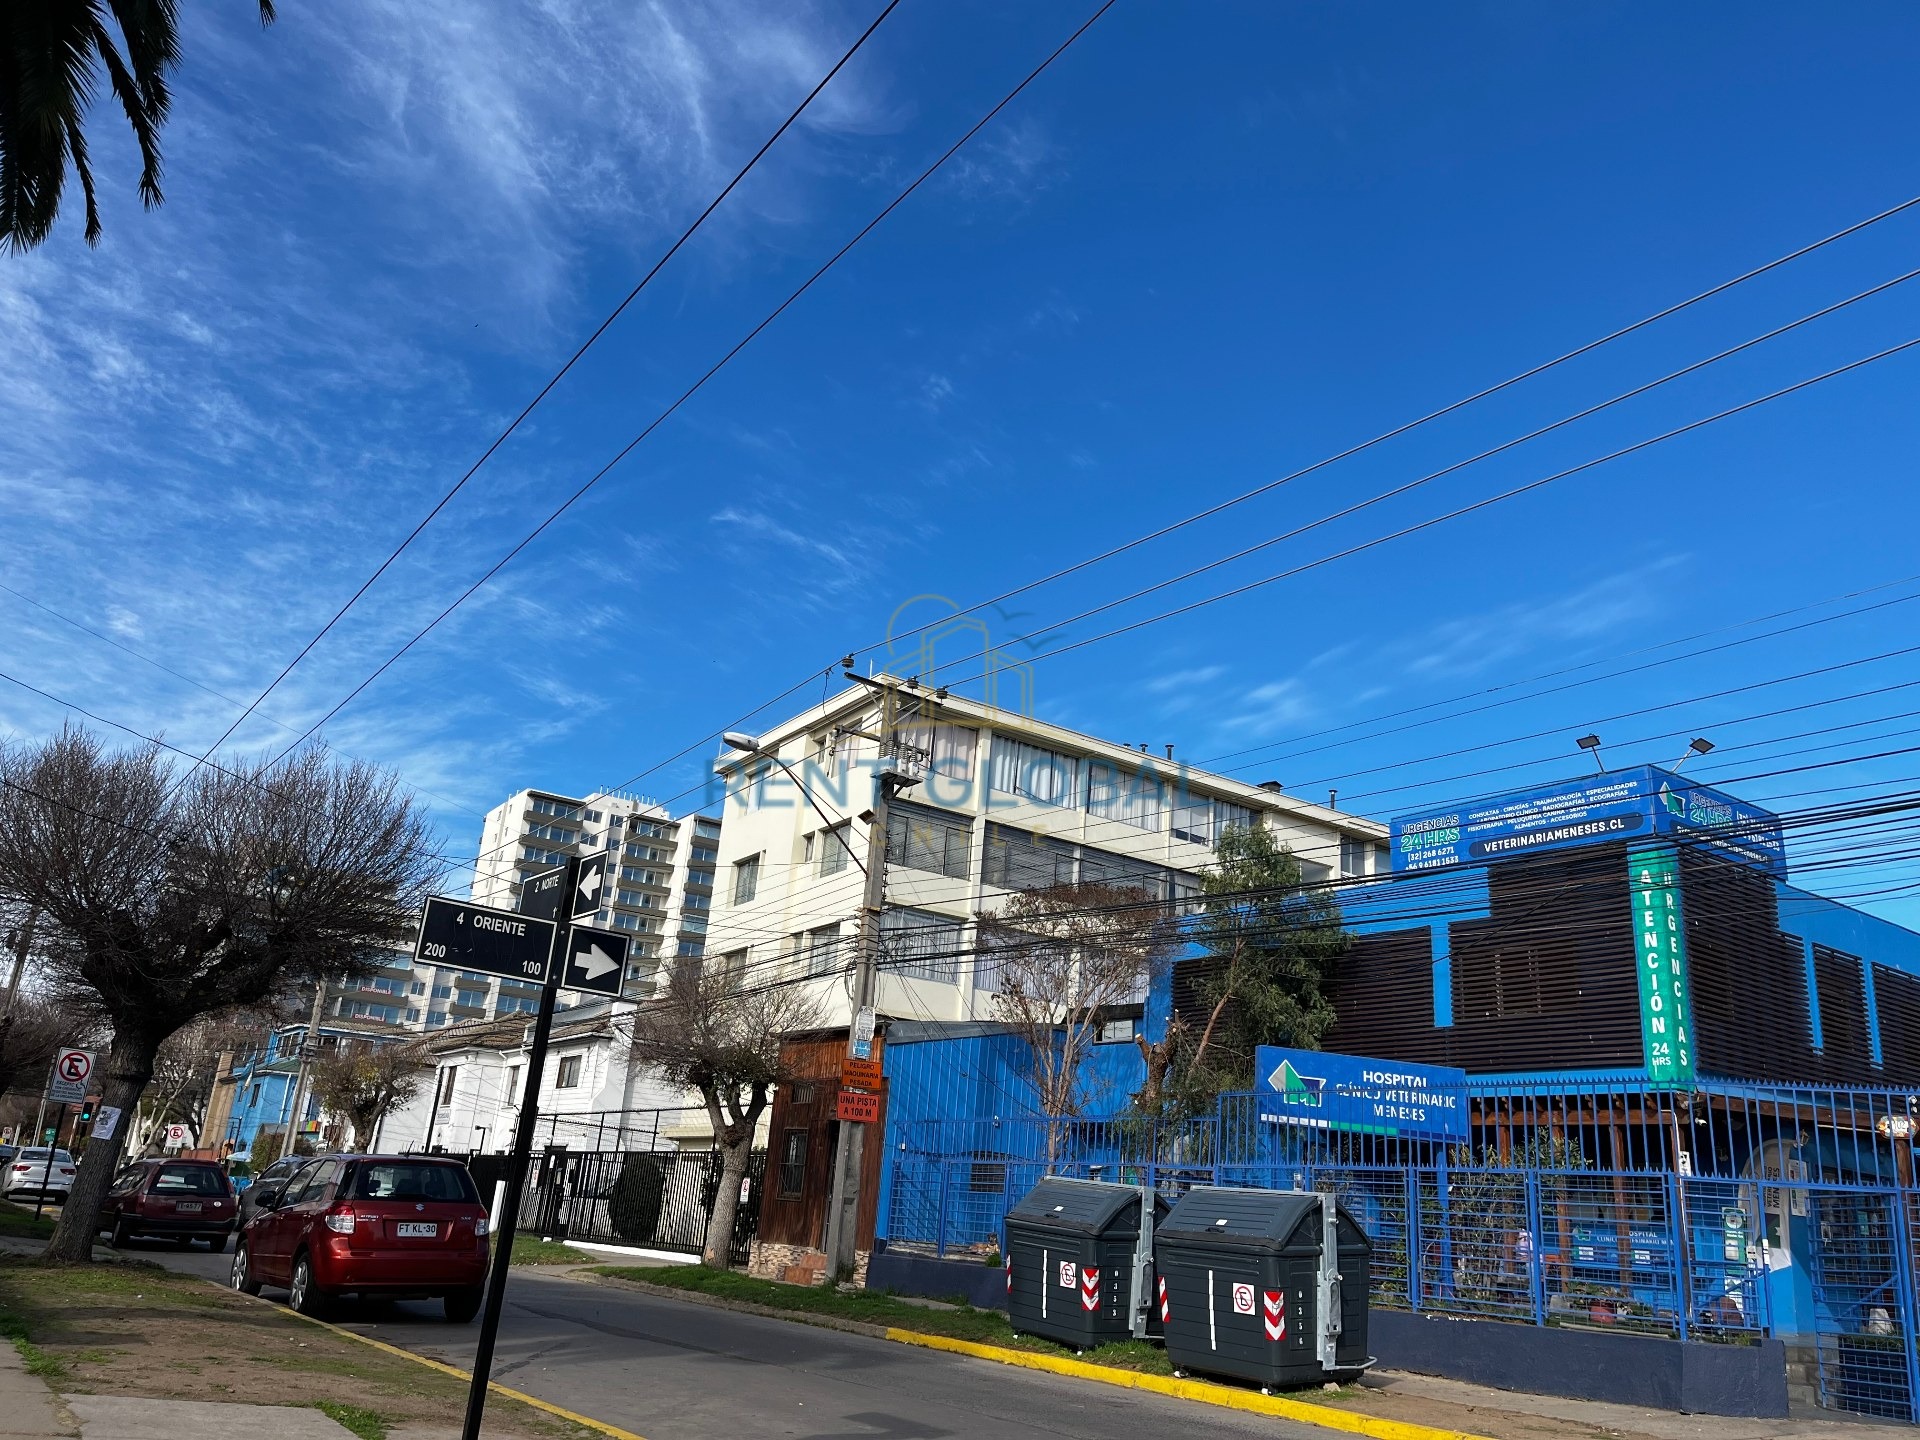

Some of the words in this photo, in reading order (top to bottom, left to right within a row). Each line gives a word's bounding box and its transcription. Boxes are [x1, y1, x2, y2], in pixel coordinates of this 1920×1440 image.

[1468, 808, 1500, 820] CONSULTAS
[1586, 781, 1638, 796] ESPECIALIDADES
[1590, 789, 1629, 802] ECOGRAFÍAS
[1514, 819, 1547, 831] ALIMENTOS
[1550, 811, 1588, 823] ACCESORIOS
[1690, 802, 1707, 826] 24
[1402, 815, 1460, 834] URGENCIAS
[1400, 832, 1422, 853] 24
[1425, 826, 1461, 849] HRS
[1484, 818, 1625, 853] VETERINARIAMENESES.CL
[1408, 851, 1422, 863] (32)
[1423, 851, 1437, 859] 268
[1438, 846, 1455, 856] 6271
[534, 881, 540, 894] 2
[541, 874, 560, 892] NORTE
[456, 912, 465, 925] 4
[473, 914, 527, 937] ORIENTE
[423, 942, 447, 959] 200
[522, 960, 541, 976] 100
[1640, 869, 1666, 1034] ATENCIÓN
[1663, 872, 1688, 1067] URGENCIAS
[1652, 1042, 1670, 1056] 24
[849, 1061, 875, 1071] PELIGRO
[1651, 1056, 1672, 1066] HRS
[844, 1069, 879, 1080] MAQUINARIA
[849, 1079, 873, 1088] PESADA
[1363, 1070, 1428, 1088] HOSPITAL
[840, 1095, 855, 1105] UNA
[857, 1096, 877, 1108] PISTA
[843, 1106, 849, 1115] A
[851, 1106, 863, 1117] 100
[865, 1107, 872, 1118] M
[1373, 1103, 1426, 1122] MENESES
[399, 1223, 410, 1233] FT
[1628, 1230, 1658, 1239] OSPITAL
